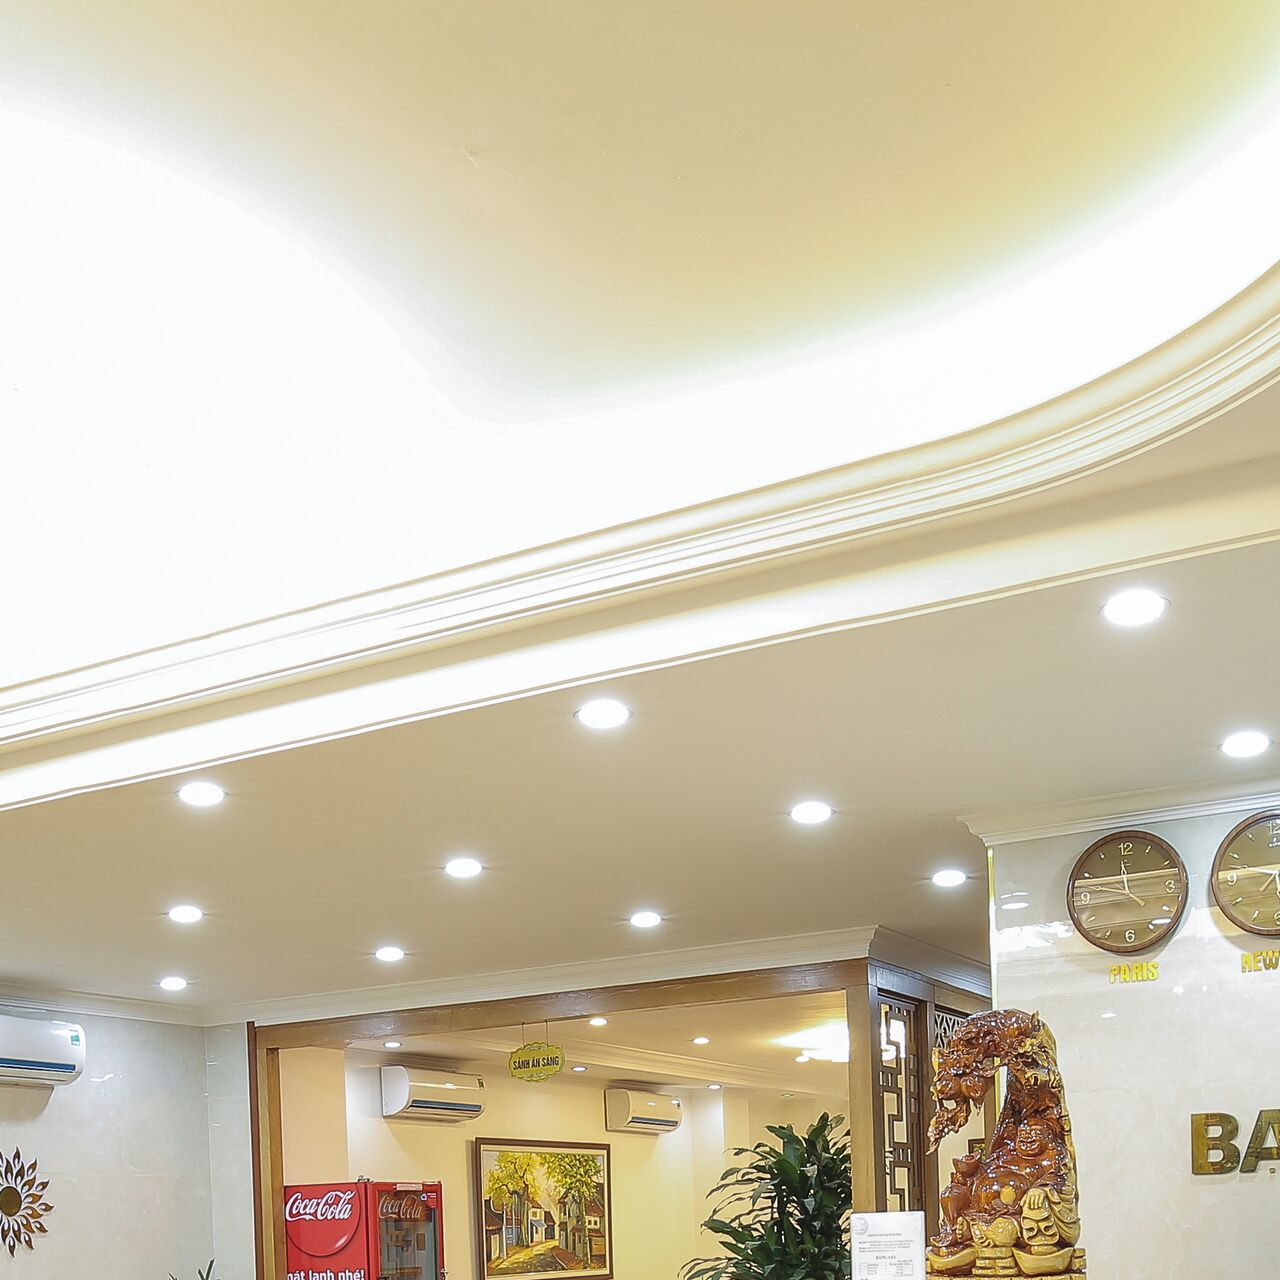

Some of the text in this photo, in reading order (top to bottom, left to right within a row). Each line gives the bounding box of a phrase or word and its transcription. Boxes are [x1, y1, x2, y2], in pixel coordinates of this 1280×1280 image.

[1118, 842, 1133, 855] 12
[1226, 872, 1237, 886] 9
[1165, 880, 1176, 893] 3
[1081, 893, 1090, 905] 9
[1125, 929, 1135, 943] 6
[1241, 950, 1280, 973] NEW
[1109, 961, 1160, 985] PARIS
[285, 1190, 356, 1222] Coca-Cola
[378, 1194, 423, 1219] Coca-Cola
